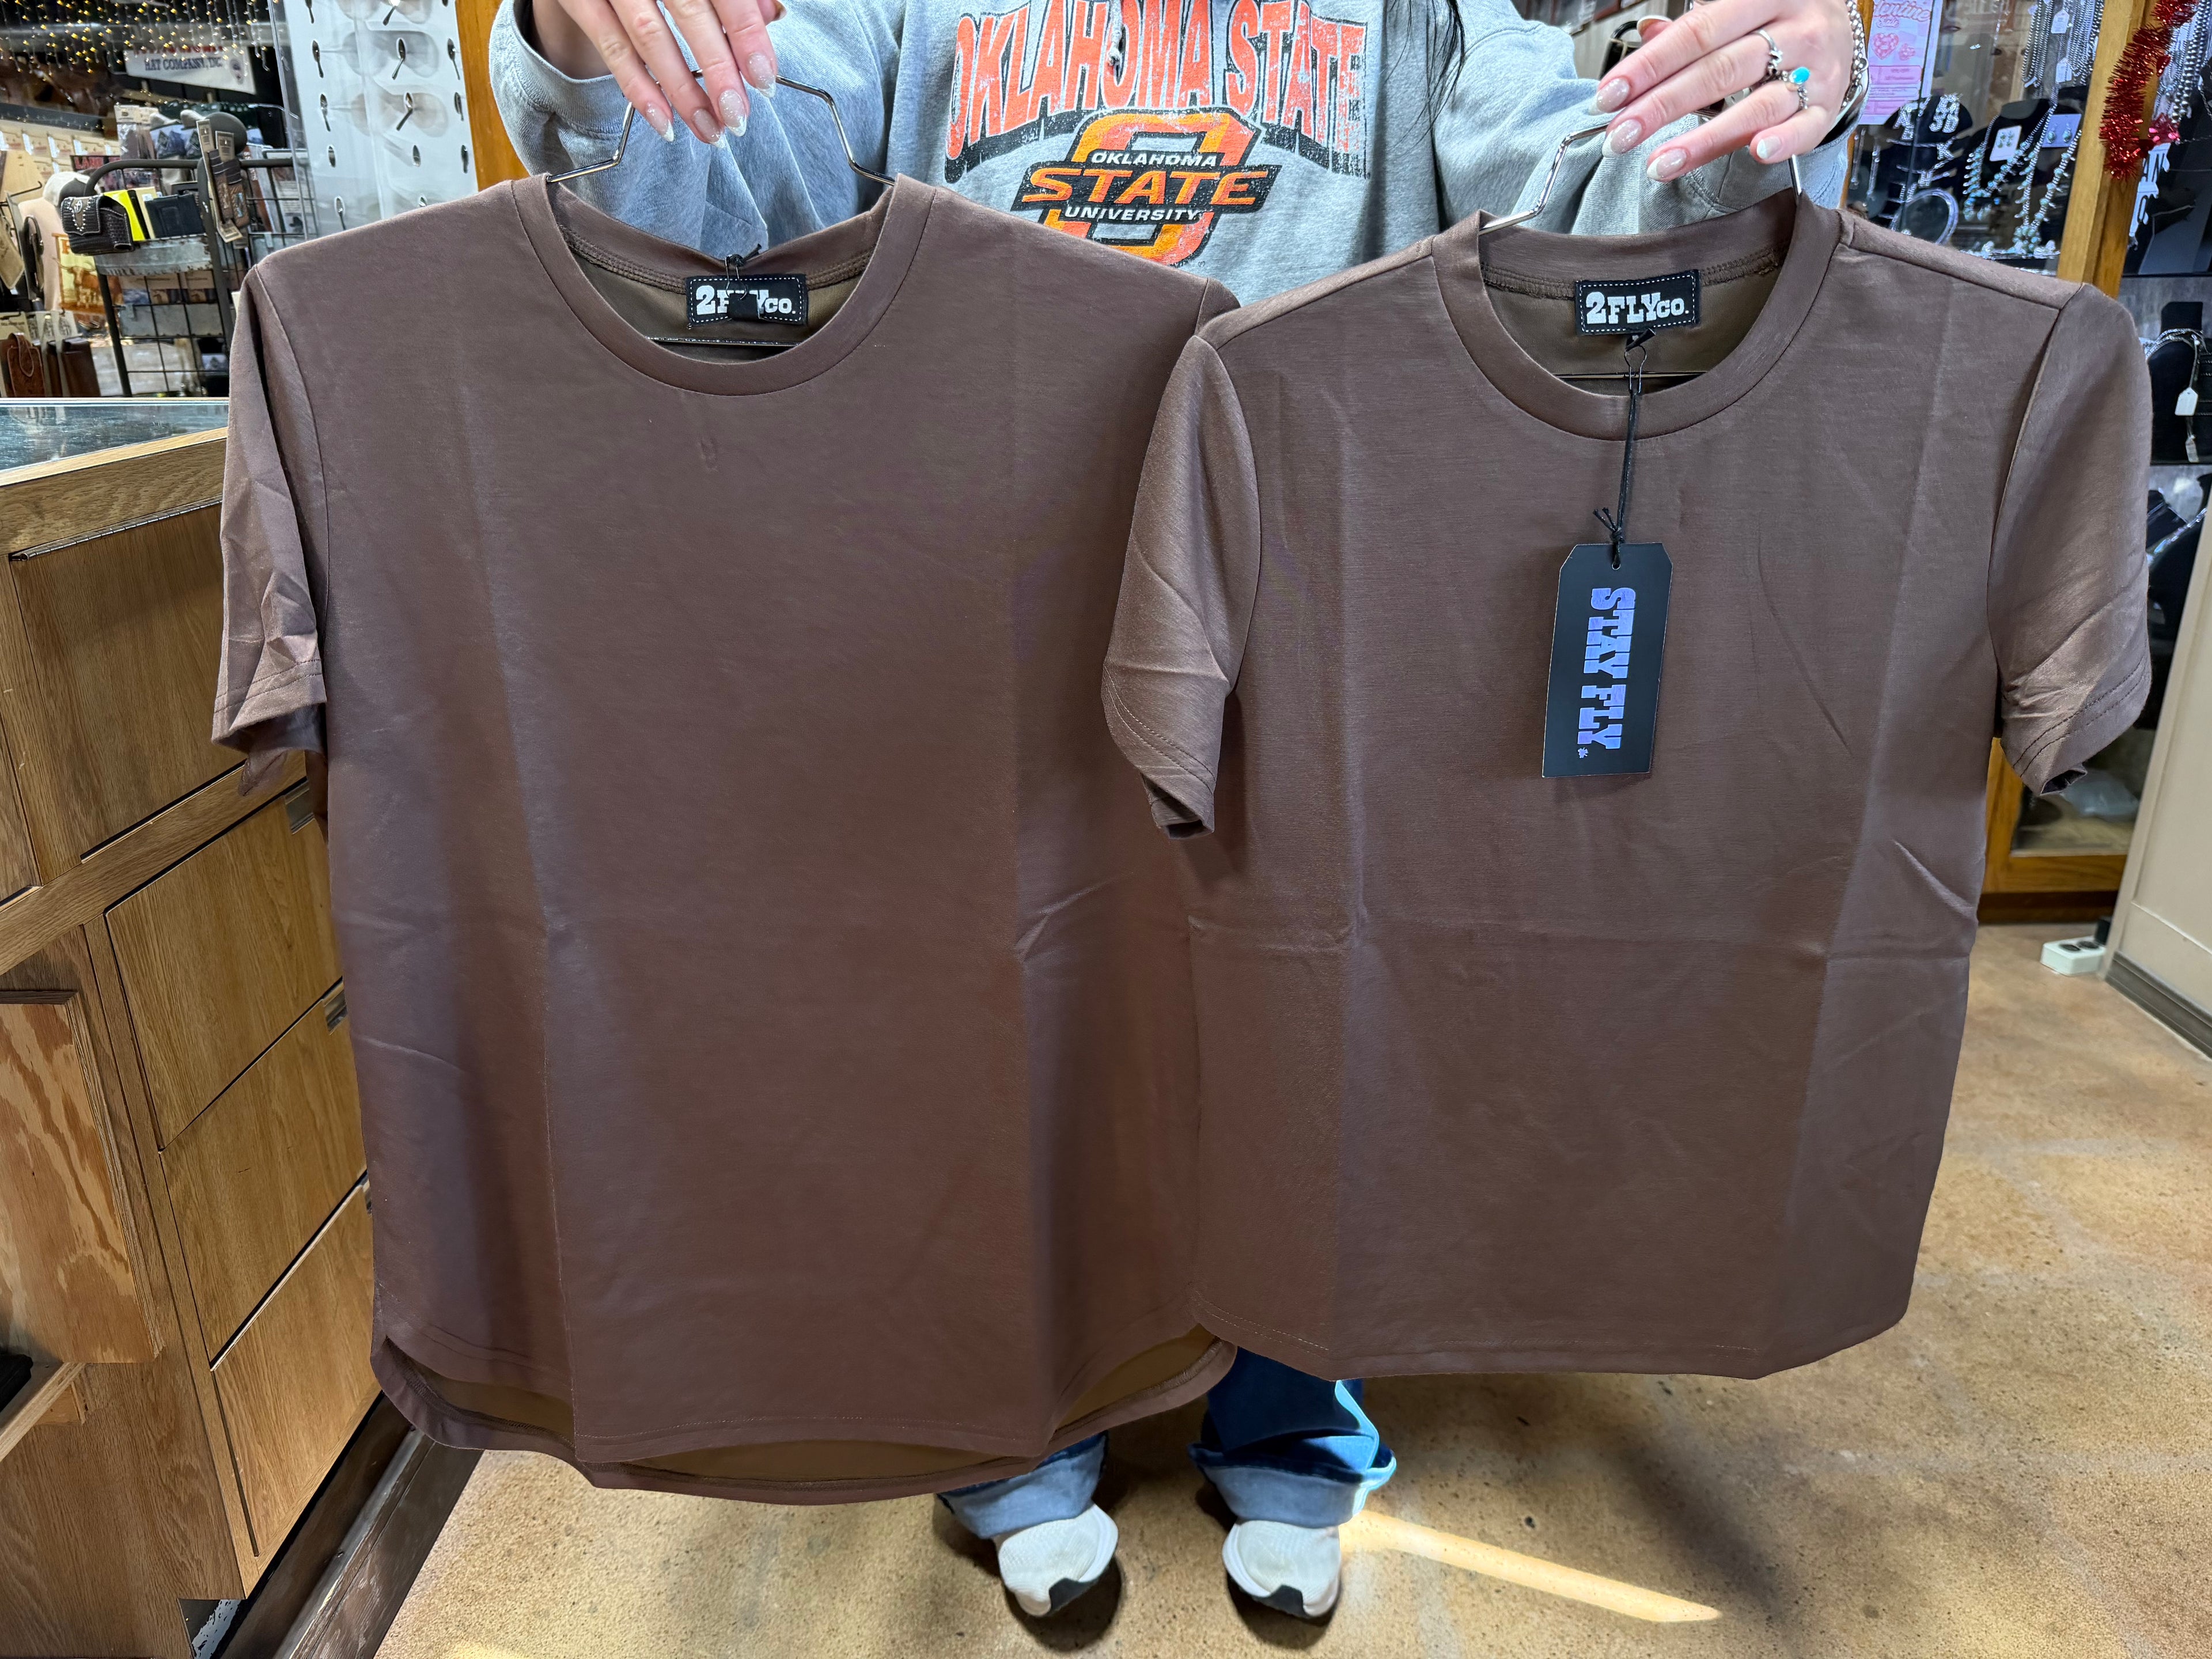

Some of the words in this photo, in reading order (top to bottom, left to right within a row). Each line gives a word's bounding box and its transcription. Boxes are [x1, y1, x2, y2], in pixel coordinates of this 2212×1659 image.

[145, 58, 161, 71] HAT
[945, 0, 1213, 164] OKLAHOMA
[1225, 0, 1367, 161] STATE
[1090, 152, 1217, 168] OKLAHOMA
[1021, 167, 1268, 206] STATE
[1064, 205, 1200, 222] UNIVERSITY
[1583, 586, 1637, 679] STAY
[1577, 684, 1627, 750] FLY
